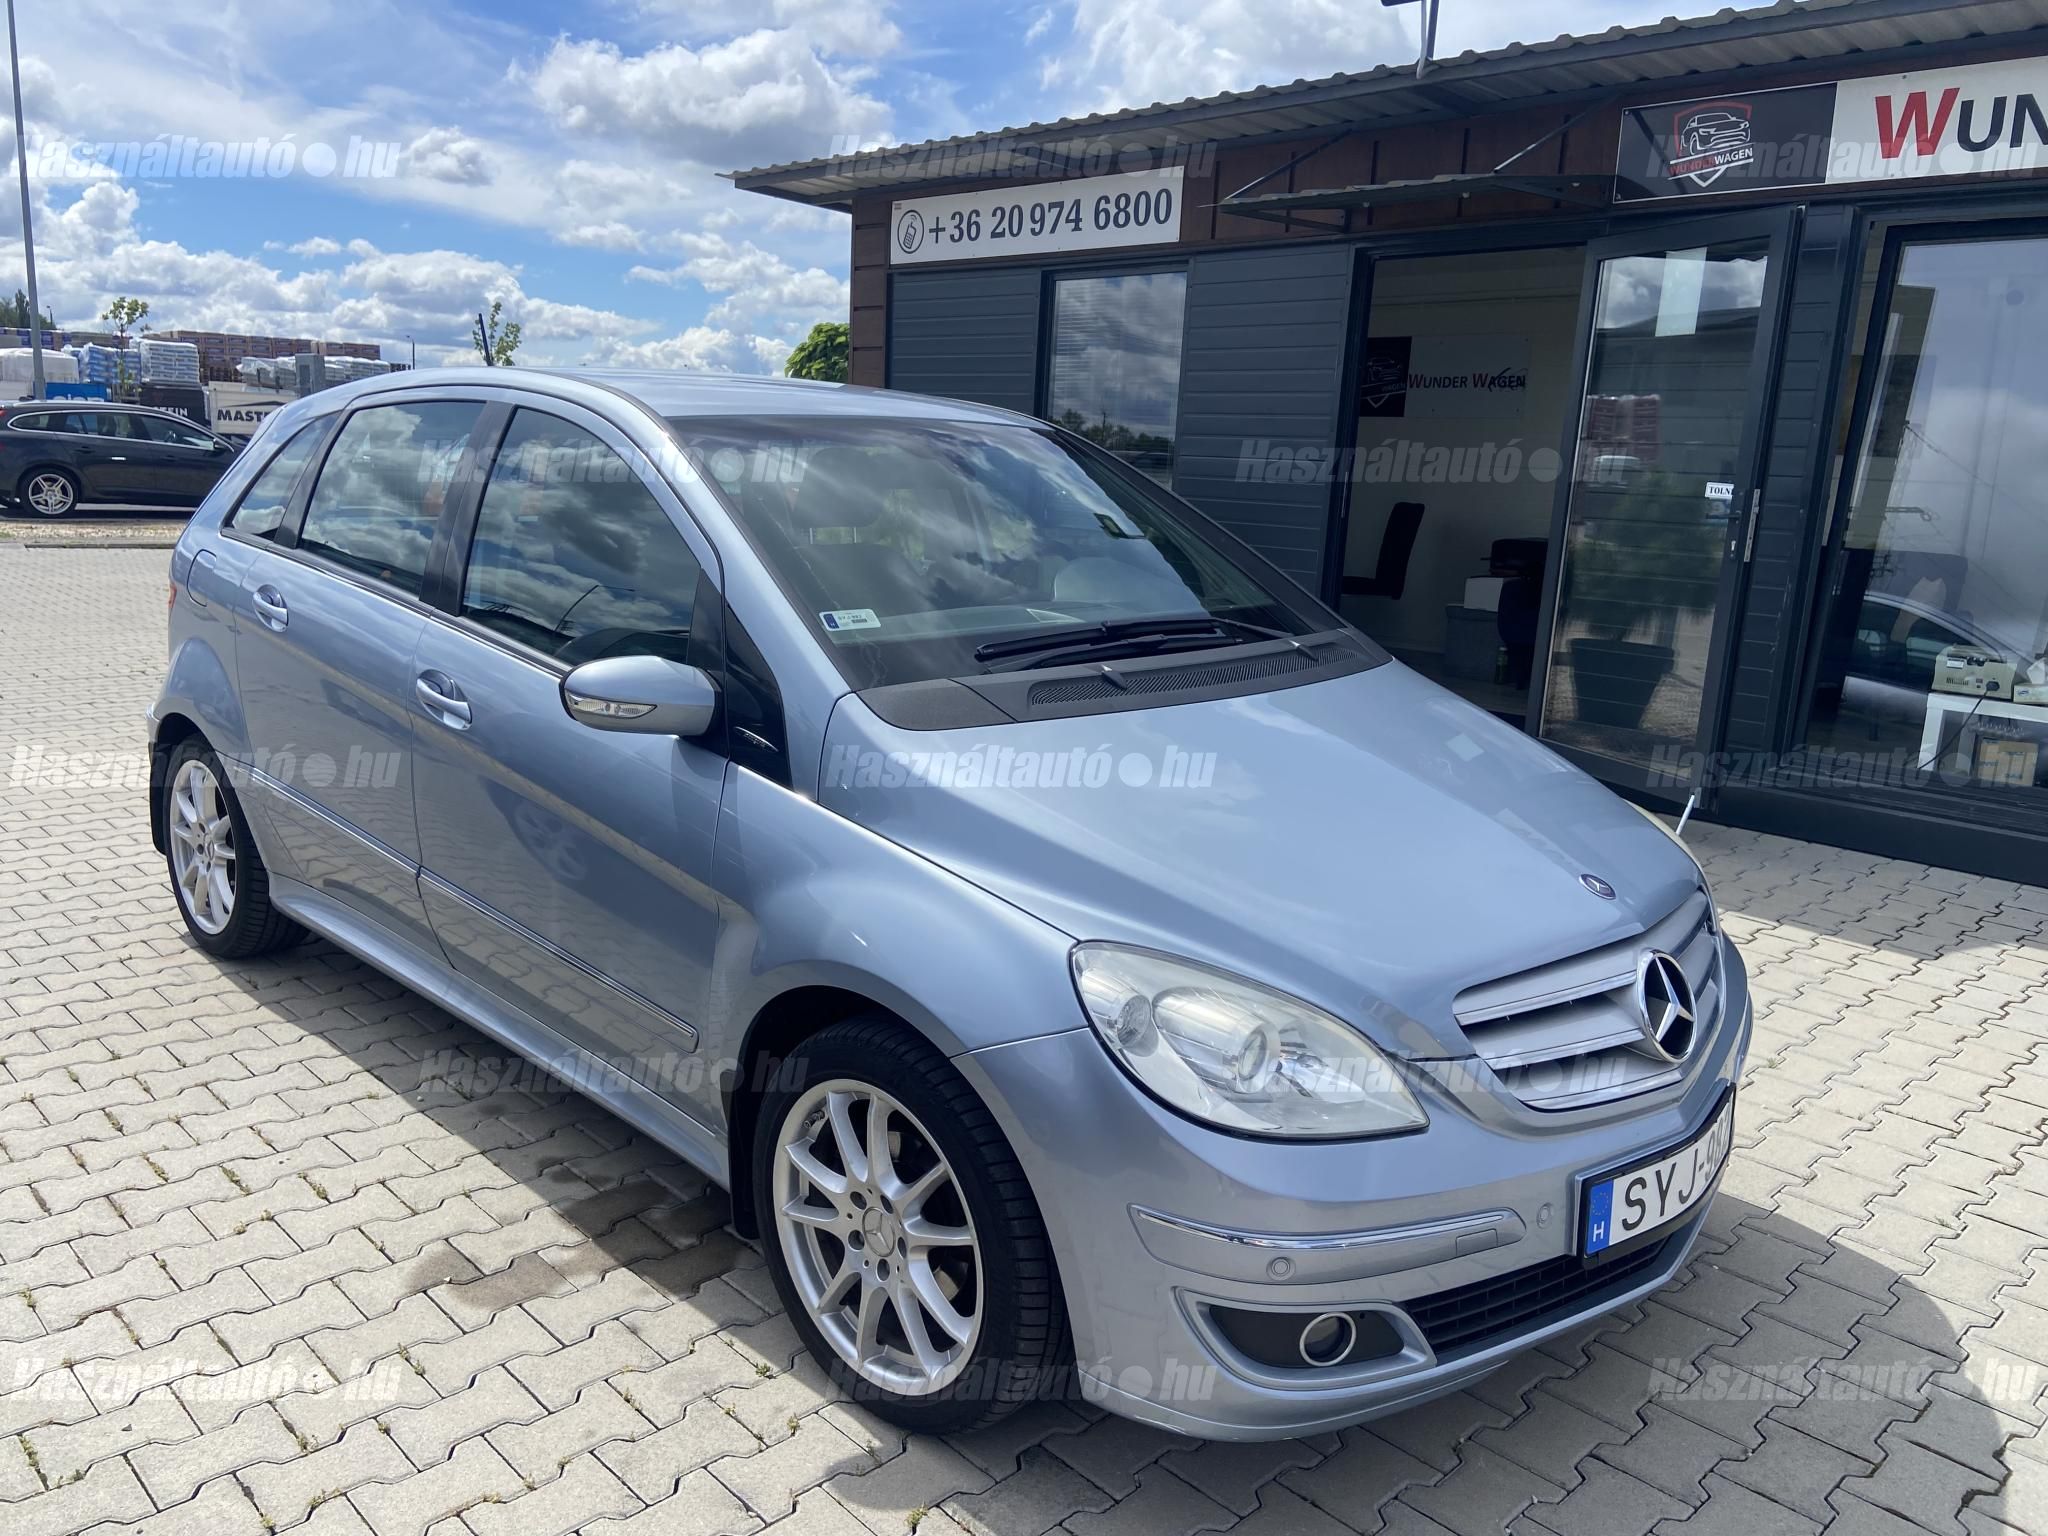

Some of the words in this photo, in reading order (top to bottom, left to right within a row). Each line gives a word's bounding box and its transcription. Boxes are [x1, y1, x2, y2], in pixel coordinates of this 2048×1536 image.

[928, 209, 981, 244] +36
[990, 204, 1024, 239] 20
[1030, 198, 1083, 236] 974
[1093, 188, 1173, 231] 6800
[1592, 1221, 1605, 1243] H
